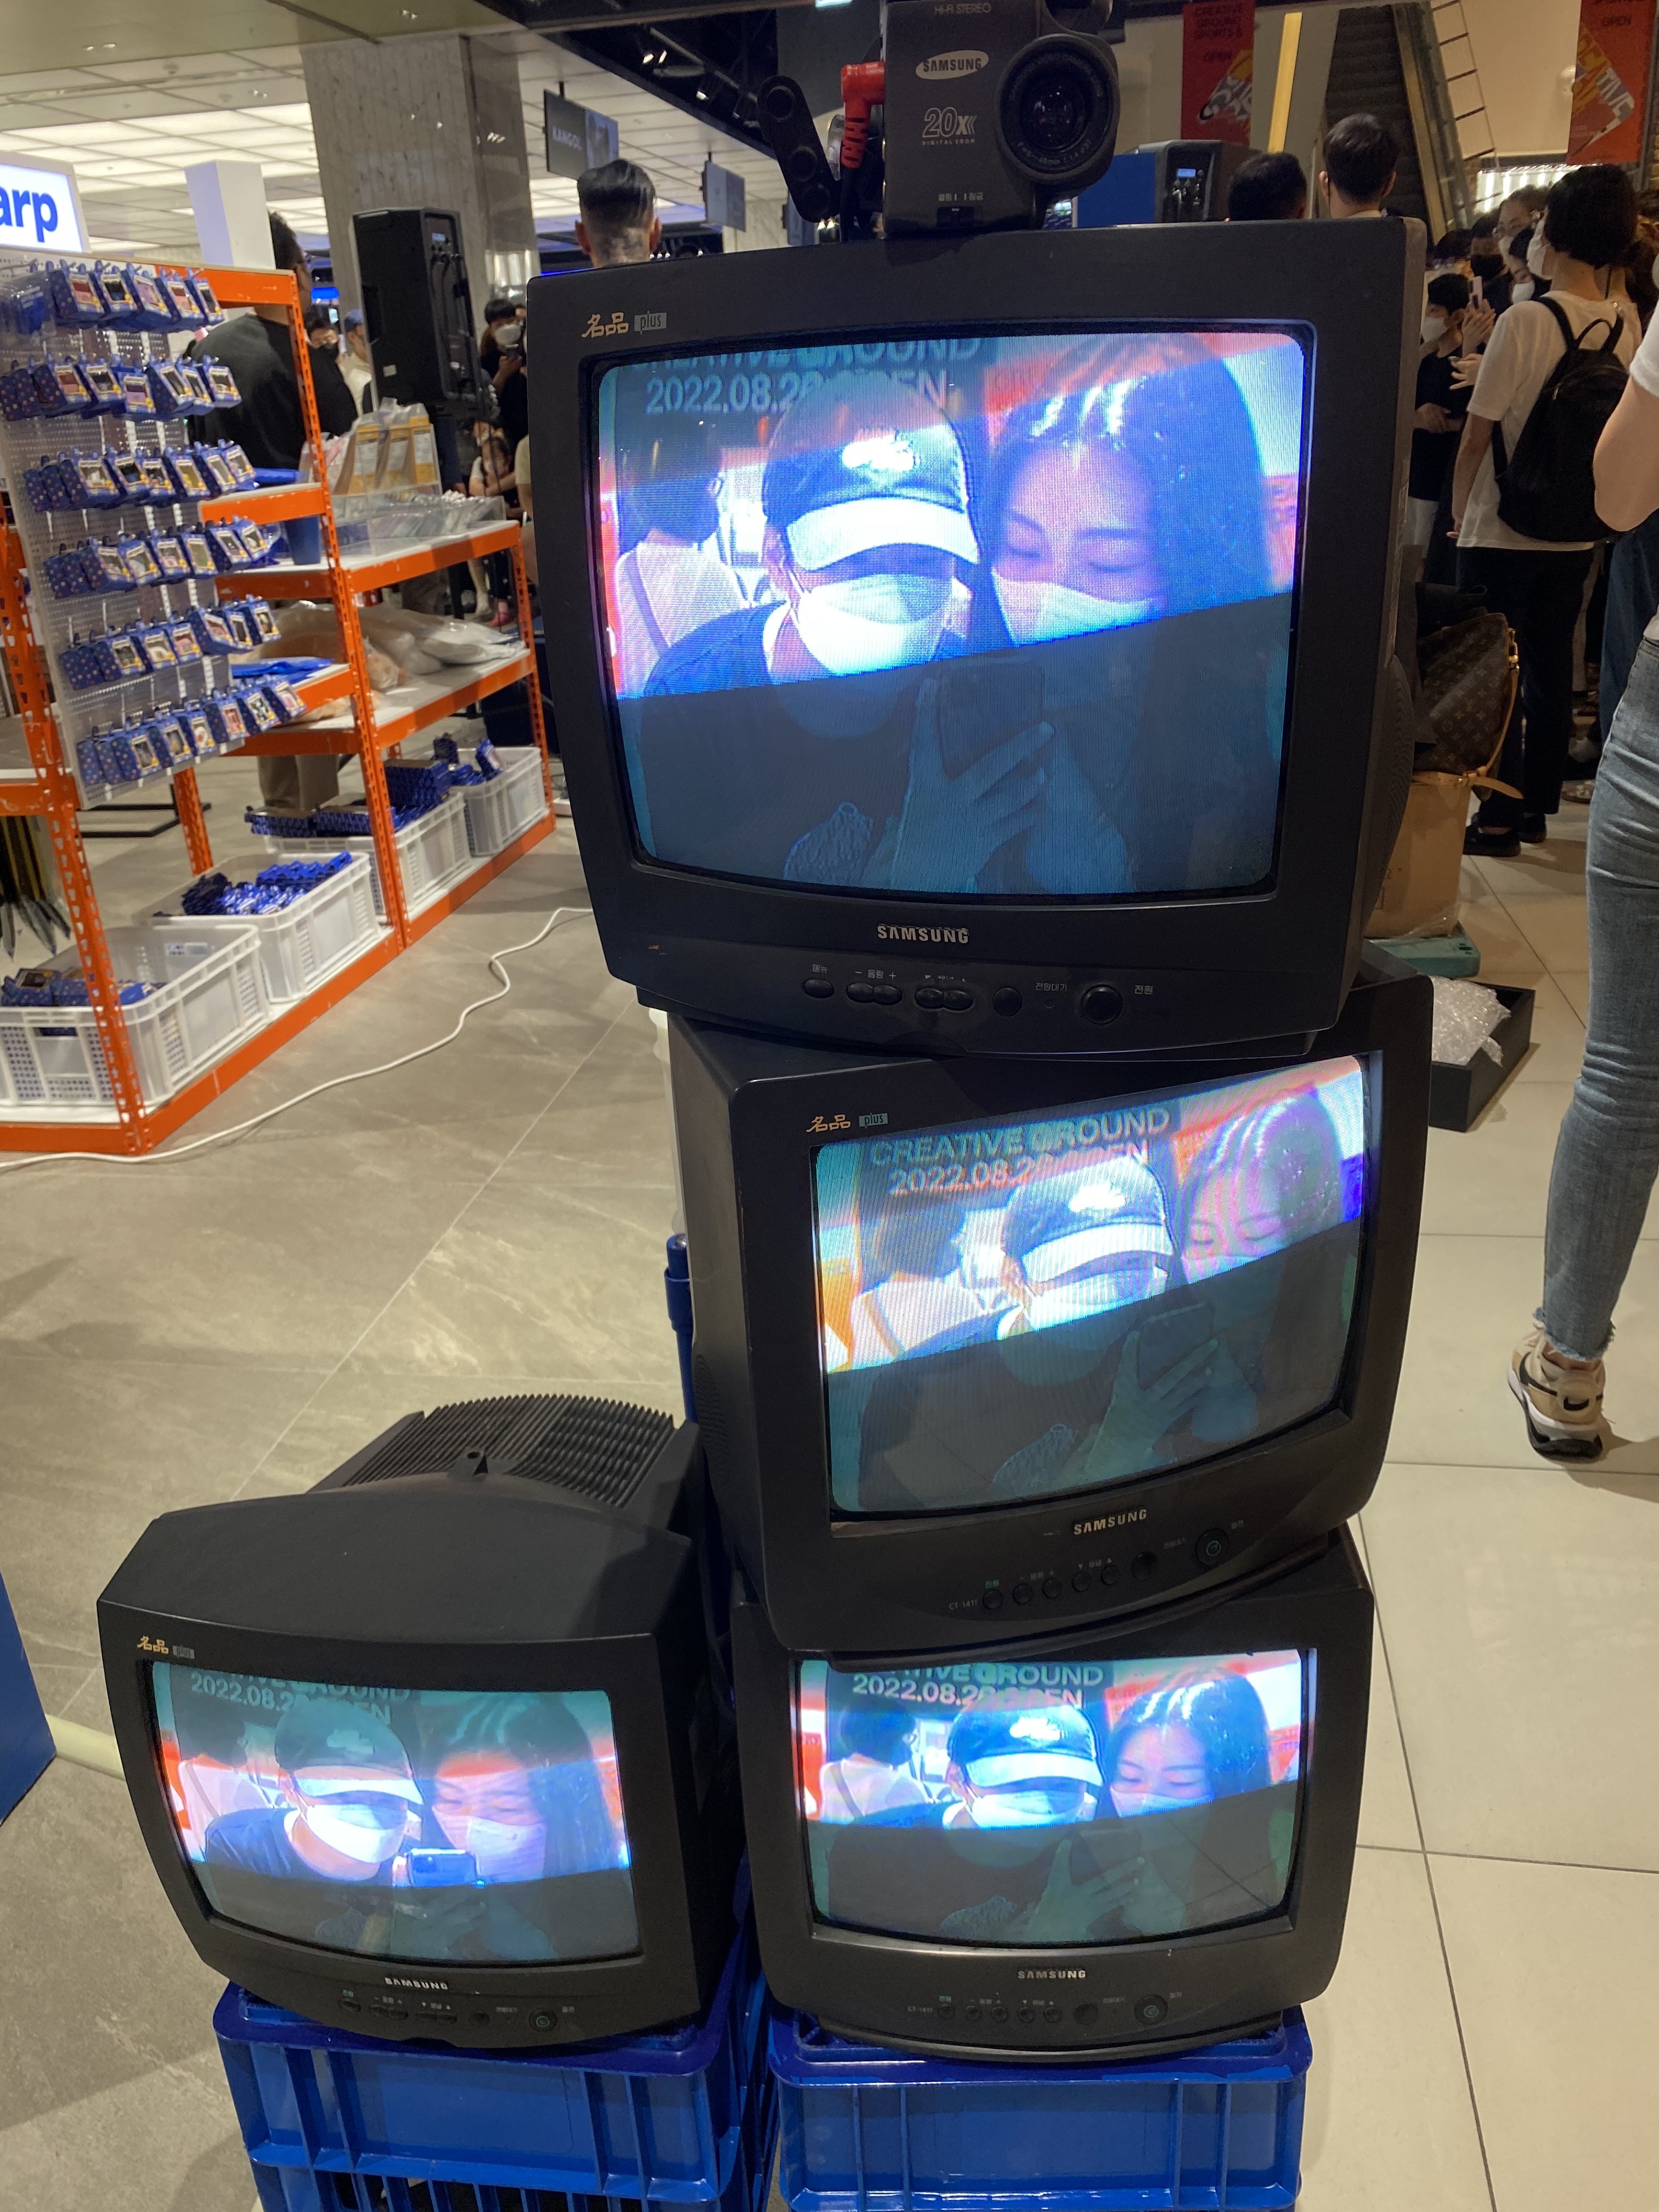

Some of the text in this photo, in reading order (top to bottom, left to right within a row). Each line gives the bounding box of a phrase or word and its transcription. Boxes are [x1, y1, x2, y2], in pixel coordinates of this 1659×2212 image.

[956, 3, 992, 14] STEREO
[923, 58, 982, 72] SAMSUNG
[581, 312, 629, 337] 名品
[638, 311, 663, 334] plus
[877, 924, 969, 944] SAMSUNG
[811, 963, 828, 974] 메뉴
[867, 969, 884, 979] 음량
[1035, 982, 1068, 991] 전원대기
[1134, 985, 1153, 995] 전원
[806, 1114, 851, 1132] 名品
[862, 1113, 885, 1128] plus
[871, 1127, 1024, 1166] CREATIVE
[1028, 1107, 1170, 1152] GROUND
[1074, 1509, 1147, 1535] SAMSUNG
[137, 1635, 169, 1654] 名品
[175, 1645, 193, 1658] plus
[1018, 1970, 1086, 1979] SAMSUNG
[384, 1977, 448, 1990] SAMSUNG
